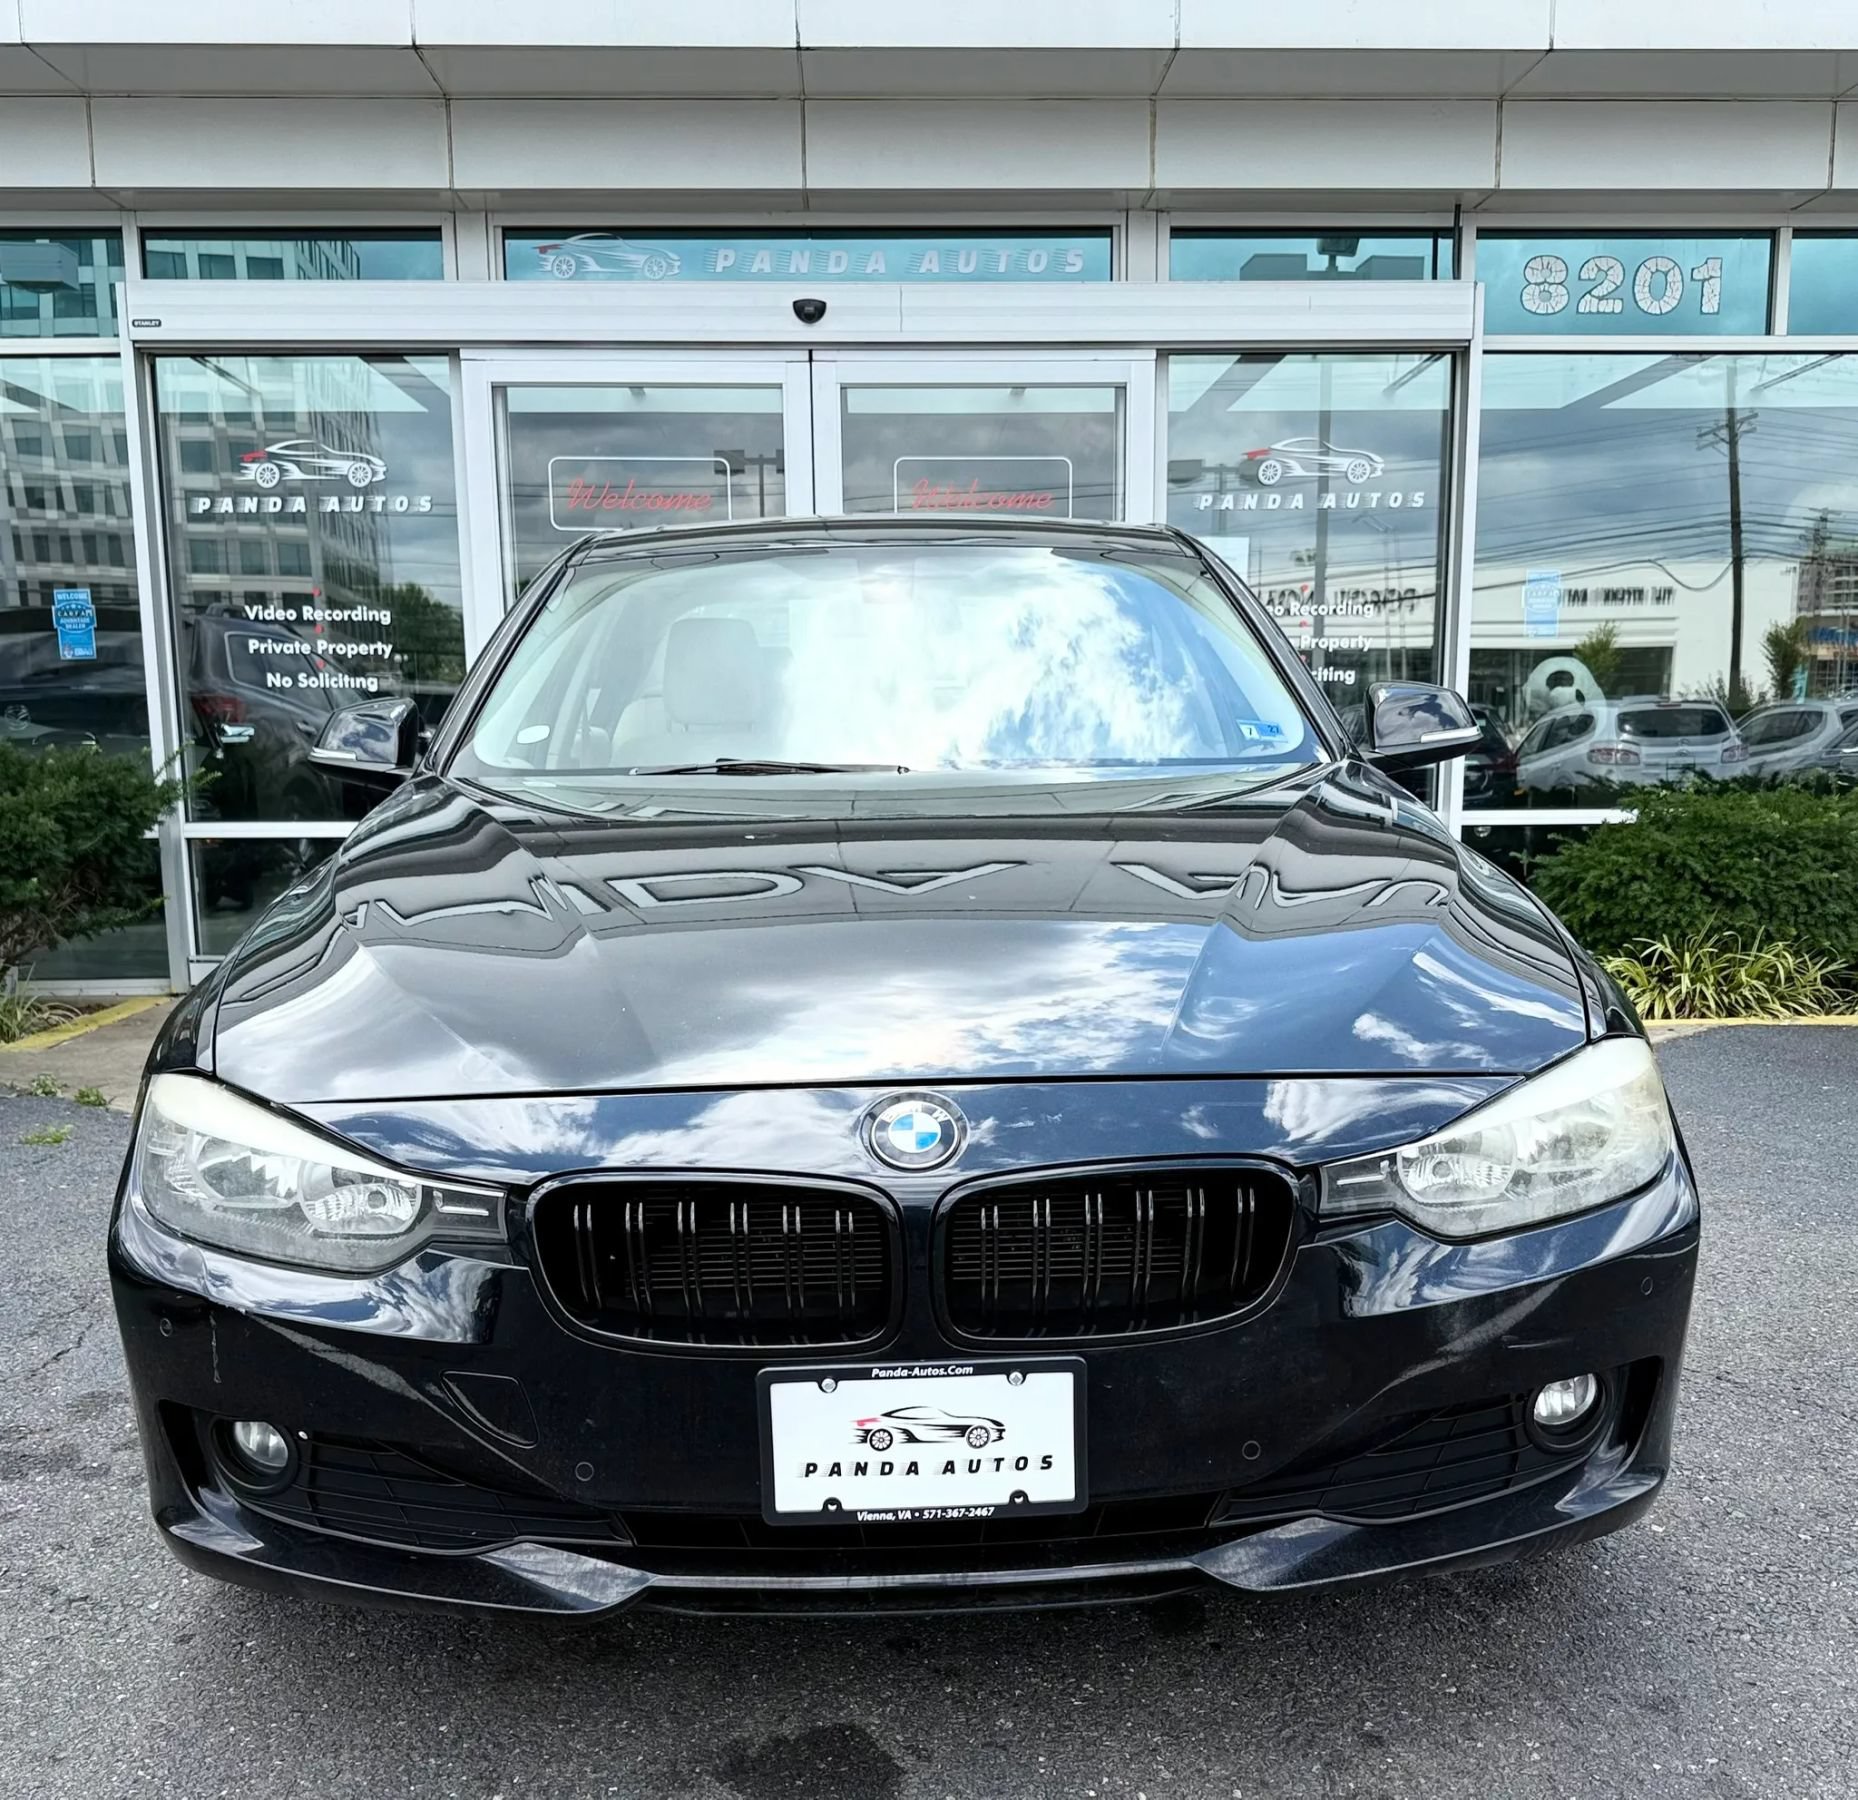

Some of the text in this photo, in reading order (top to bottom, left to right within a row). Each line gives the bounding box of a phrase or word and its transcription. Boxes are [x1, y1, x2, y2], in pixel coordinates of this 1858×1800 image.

[706, 248, 1084, 275] PANDA AUTOS
[1520, 254, 1723, 316] 8201
[191, 495, 433, 514] PANDA AUTOS
[567, 478, 712, 512] Welcome
[911, 477, 1054, 511] Welcome
[1196, 492, 1425, 510] PANDA AUTOS
[244, 604, 392, 626] Video Recording
[1289, 601, 1375, 618] Recording
[248, 638, 393, 660] Private Property
[1301, 634, 1373, 652] Property
[266, 672, 379, 693] No Soliciting
[871, 1364, 974, 1379] Panda-Autos.Com
[799, 1454, 1053, 1478] PANDA AUTOS
[856, 1506, 995, 1522] Vienna, VA 571-367-2467
